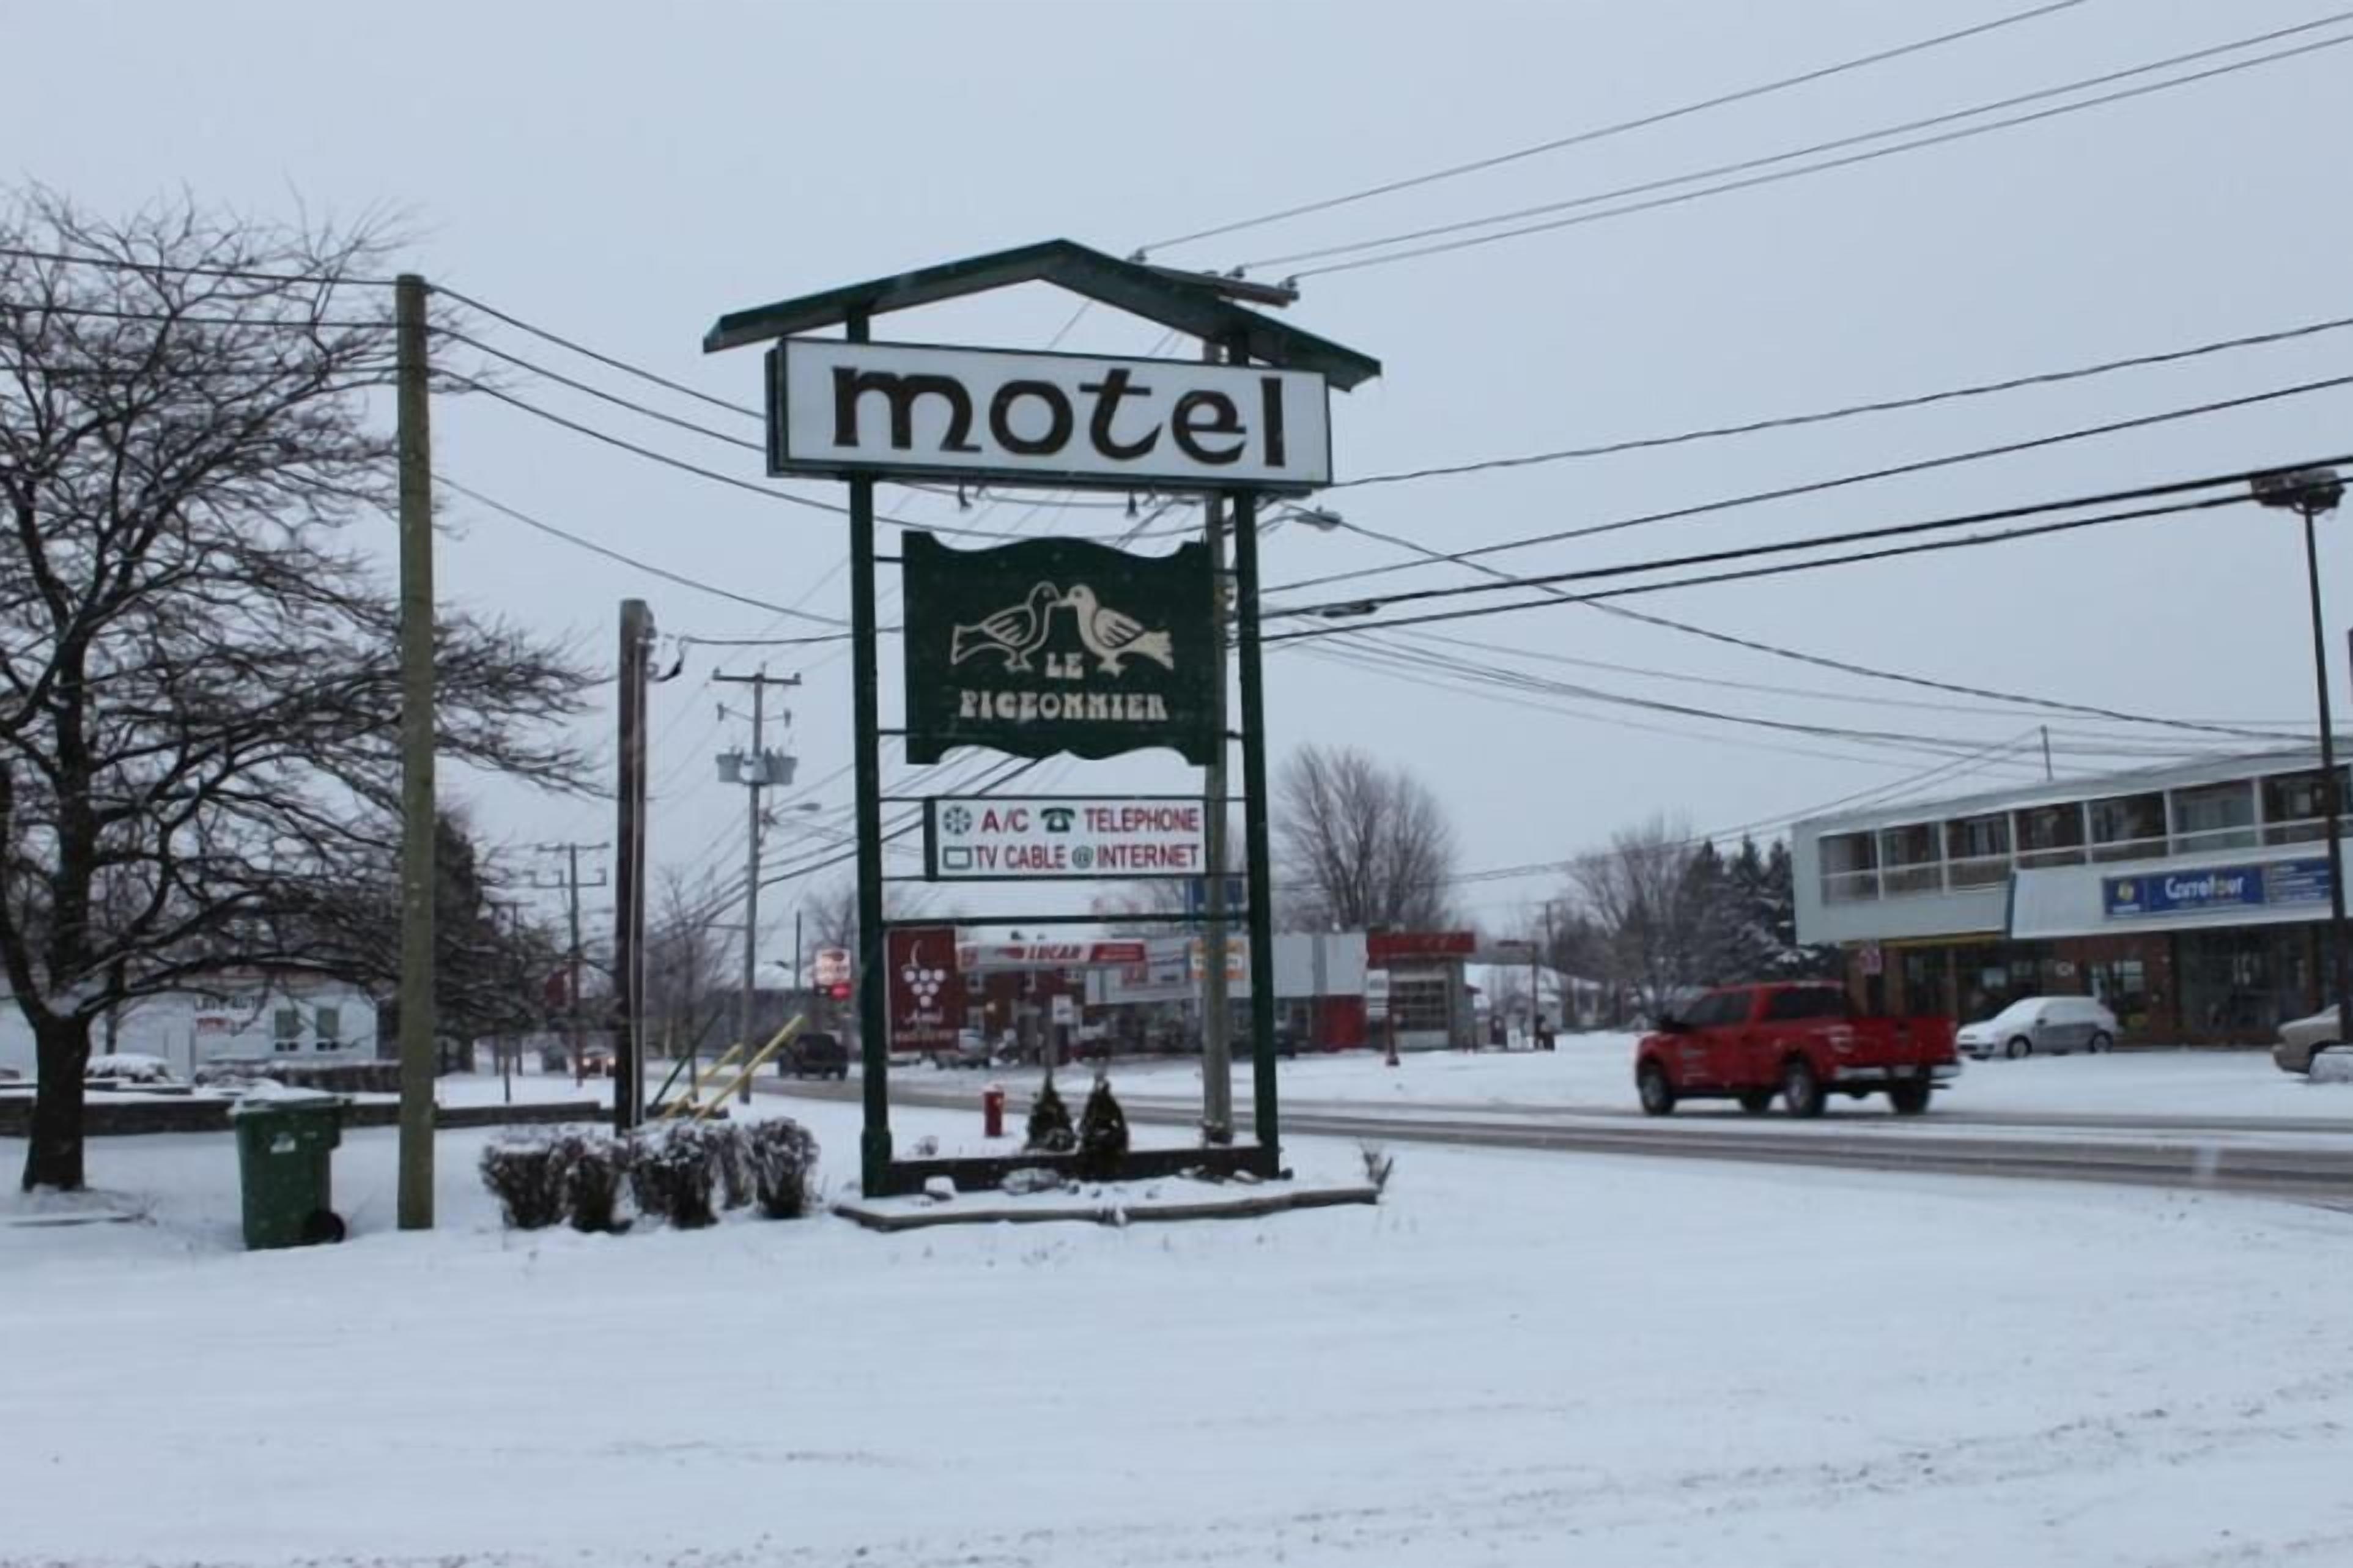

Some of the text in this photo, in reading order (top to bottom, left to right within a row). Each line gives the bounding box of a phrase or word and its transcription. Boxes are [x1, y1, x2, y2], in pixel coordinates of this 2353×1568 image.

[832, 366, 1285, 467] motel
[1045, 652, 1084, 679] LE
[959, 690, 1169, 722] PIGEONNIER
[981, 807, 1200, 833] A/C TELEPHONE
[975, 843, 1199, 869] TV CABLE INTERNET
